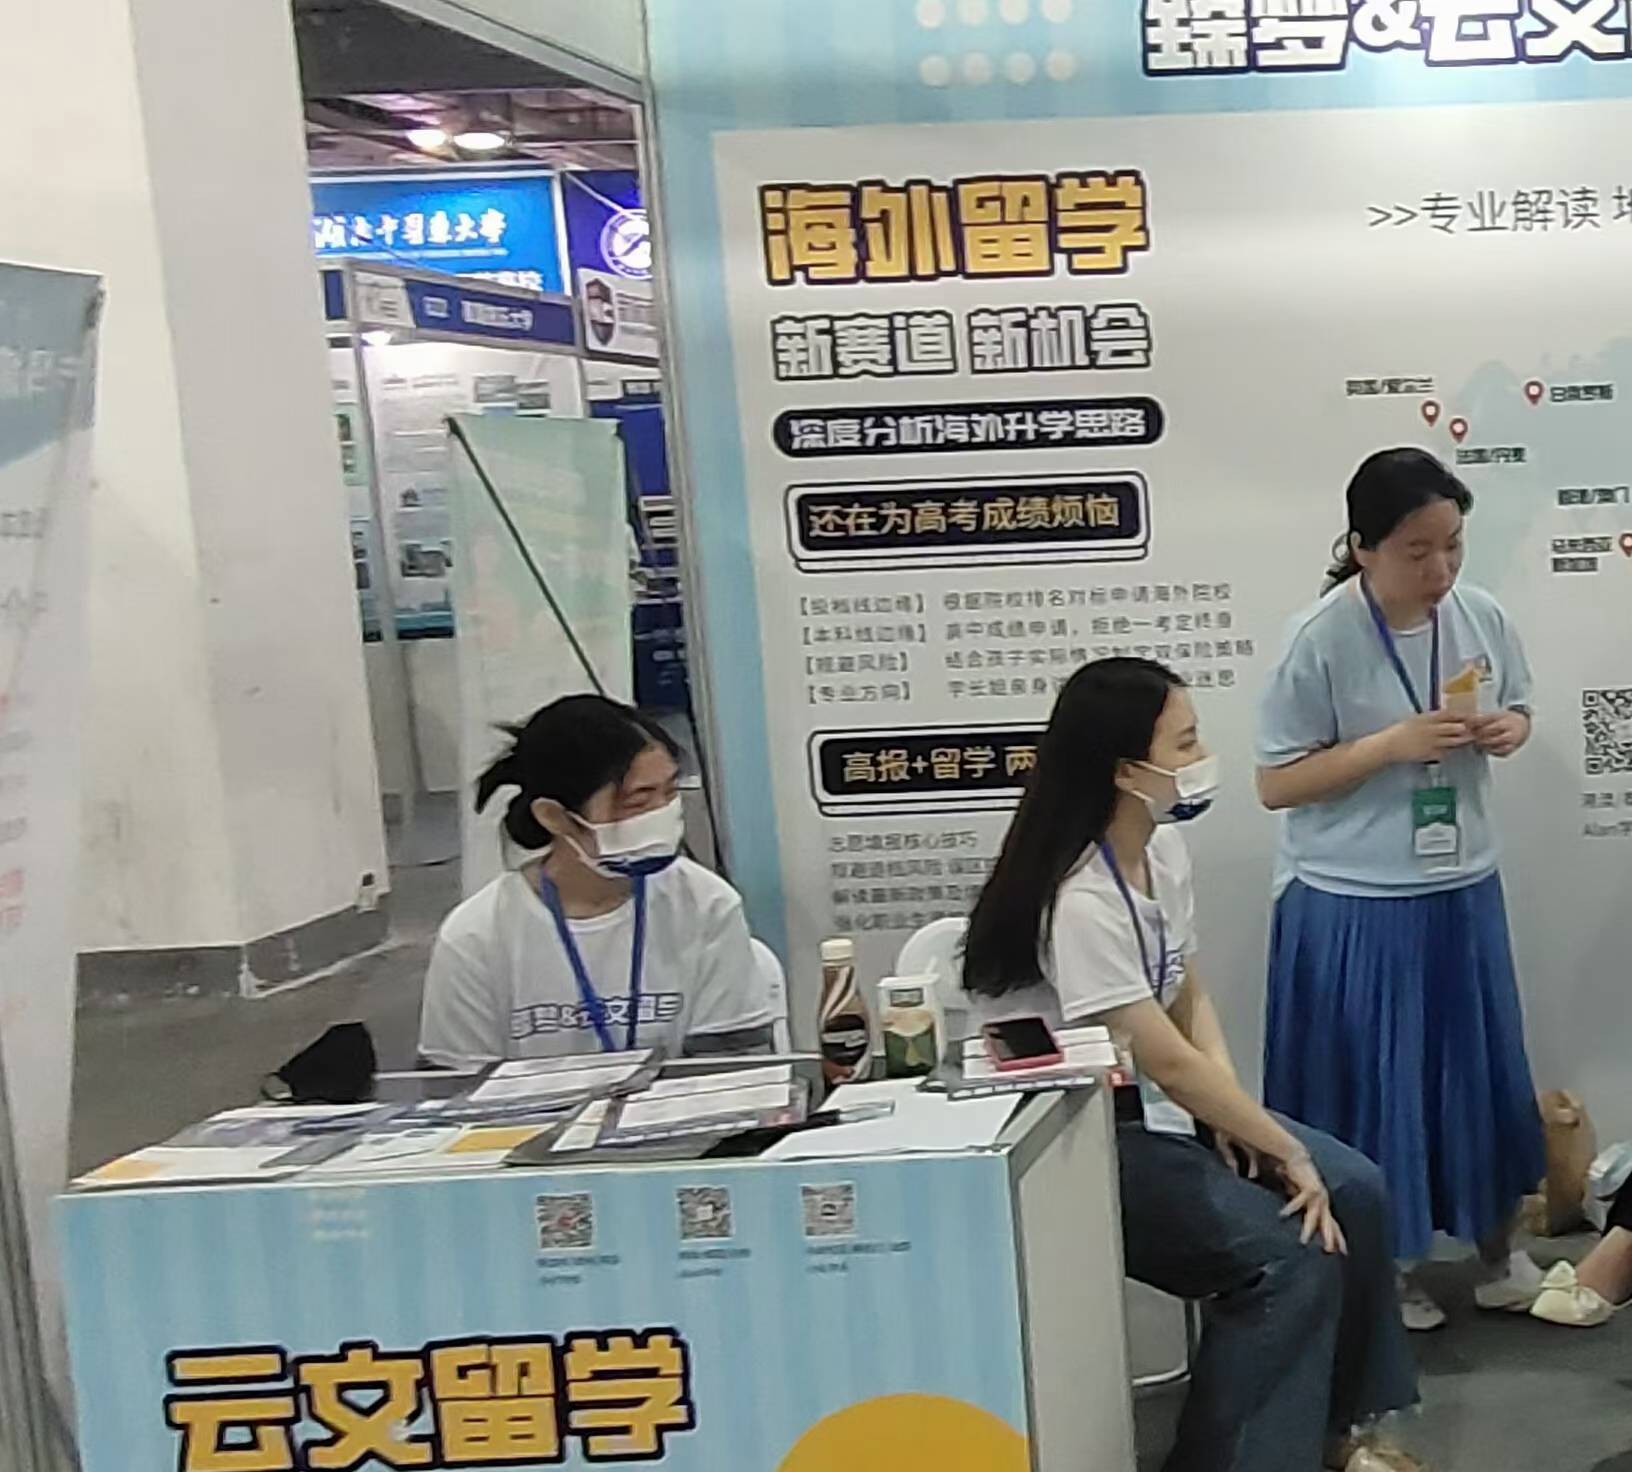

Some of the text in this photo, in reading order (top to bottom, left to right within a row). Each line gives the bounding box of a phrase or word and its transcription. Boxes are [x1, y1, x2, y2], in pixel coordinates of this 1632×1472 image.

[758, 169, 1150, 285] 海外留学
[771, 303, 1152, 380] 新赛道 新机会
[788, 408, 1147, 450] 深度分析海外升学思路
[808, 493, 1121, 539] 还在为高考成绩烦恼
[842, 746, 997, 783] 高报+留学
[164, 1327, 693, 1472] 云文留学
